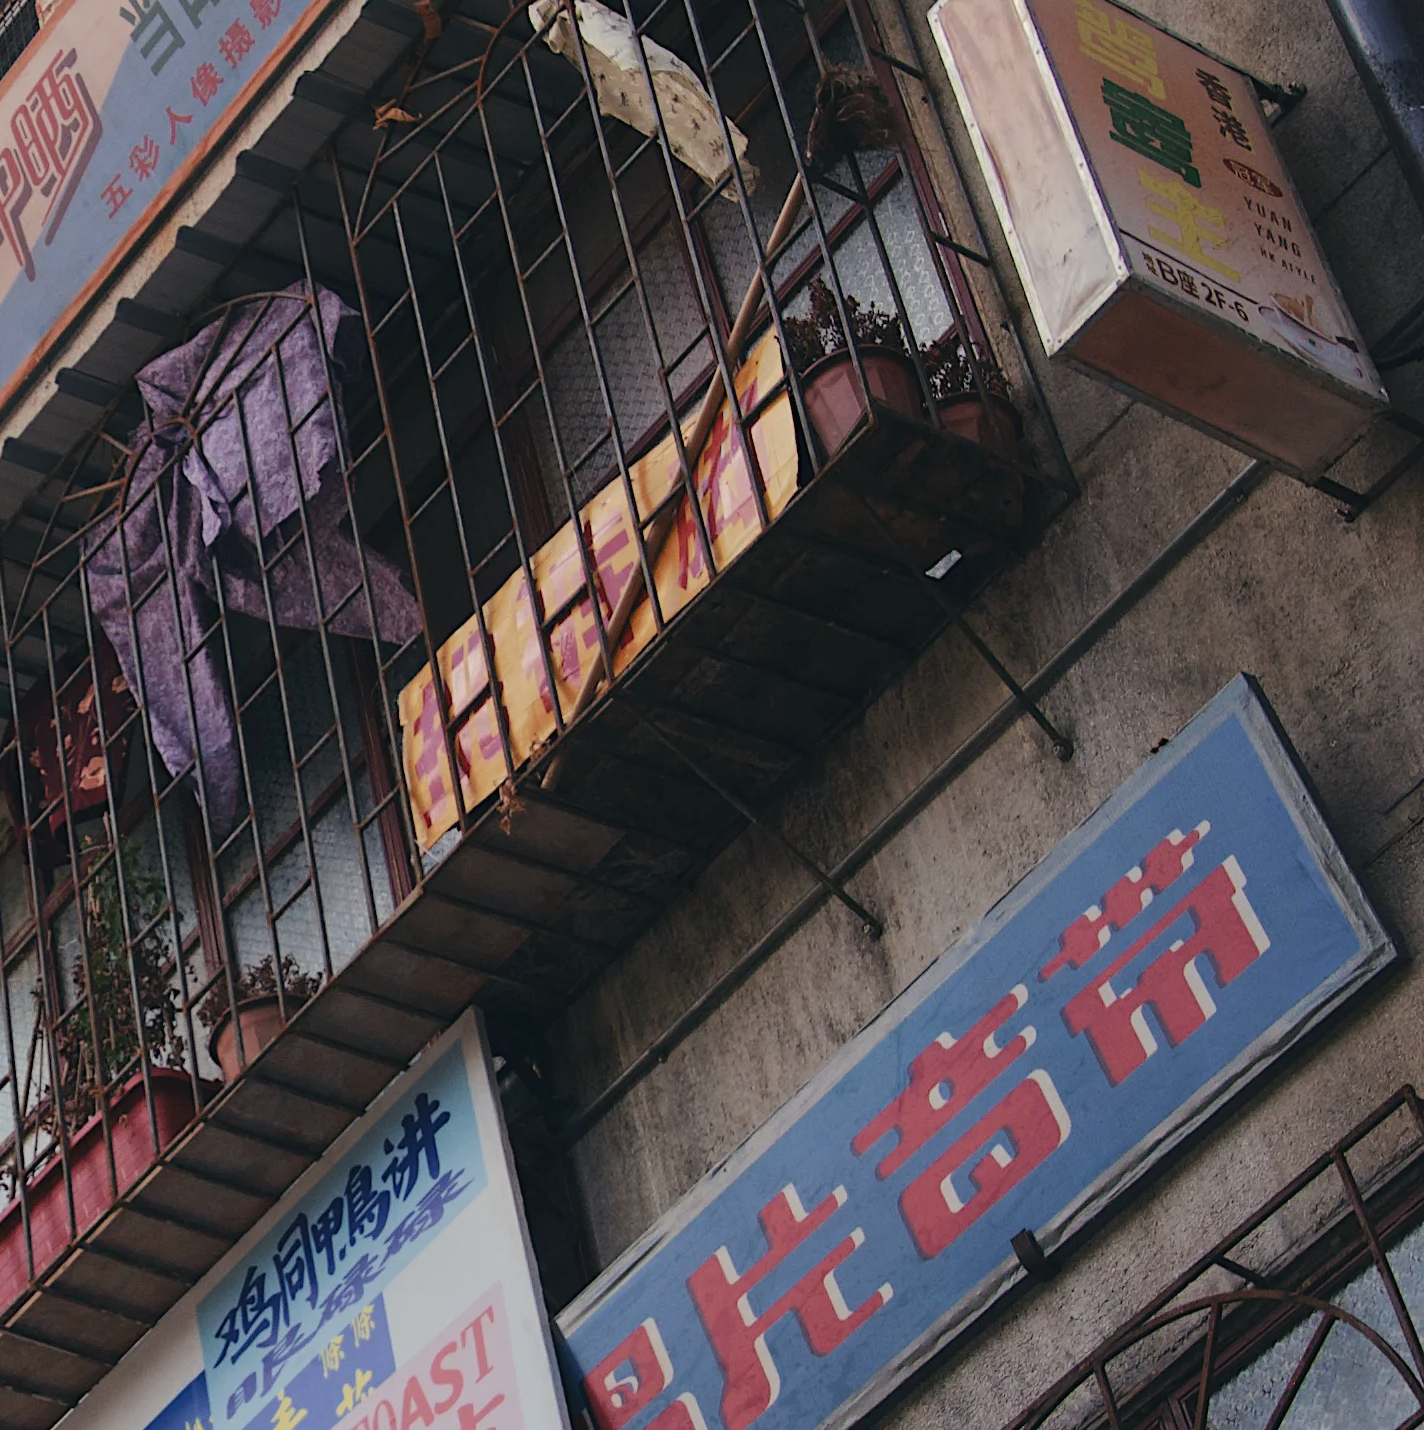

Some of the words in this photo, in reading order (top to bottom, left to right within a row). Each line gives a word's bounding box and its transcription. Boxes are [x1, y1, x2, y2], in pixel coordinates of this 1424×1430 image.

[1196, 67, 1253, 153] 香港
[1242, 195, 1294, 234] YUAN
[1254, 221, 1303, 260] YANG
[1204, 286, 1250, 323] 2F-6
